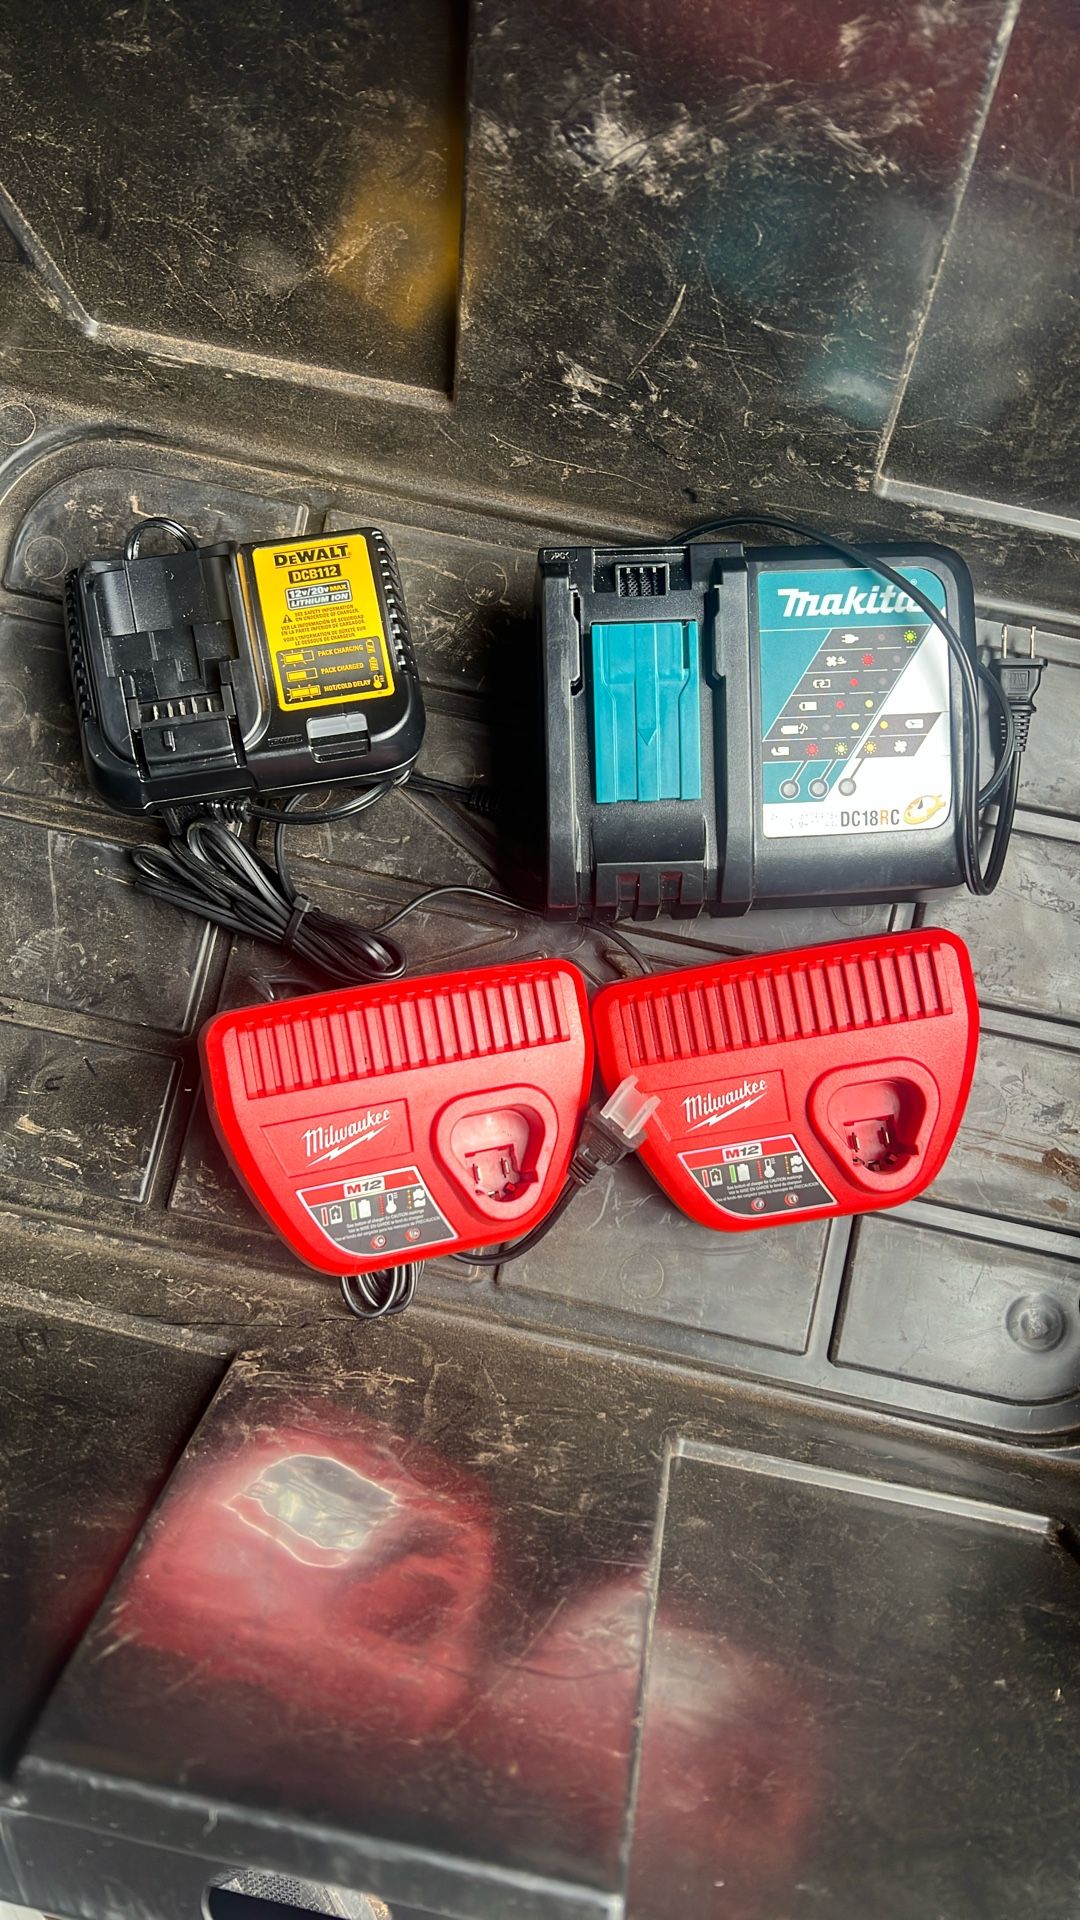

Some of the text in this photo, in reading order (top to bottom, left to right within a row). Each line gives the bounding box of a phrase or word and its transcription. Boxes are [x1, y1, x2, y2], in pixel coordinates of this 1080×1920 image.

[292, 566, 338, 582] DCB112
[330, 584, 347, 592] MAX
[291, 592, 348, 608] LITHIUM ION
[317, 644, 363, 656] PACK CHARGING
[320, 662, 364, 674] PACK CHARGED
[323, 679, 371, 691] HOT/COLD DELAY
[840, 809, 900, 828] DC18RC
[680, 1079, 768, 1123] Milwaukee
[301, 1109, 391, 1157] Milwaukee
[725, 1145, 760, 1160] M12
[346, 1179, 382, 1195] M12
